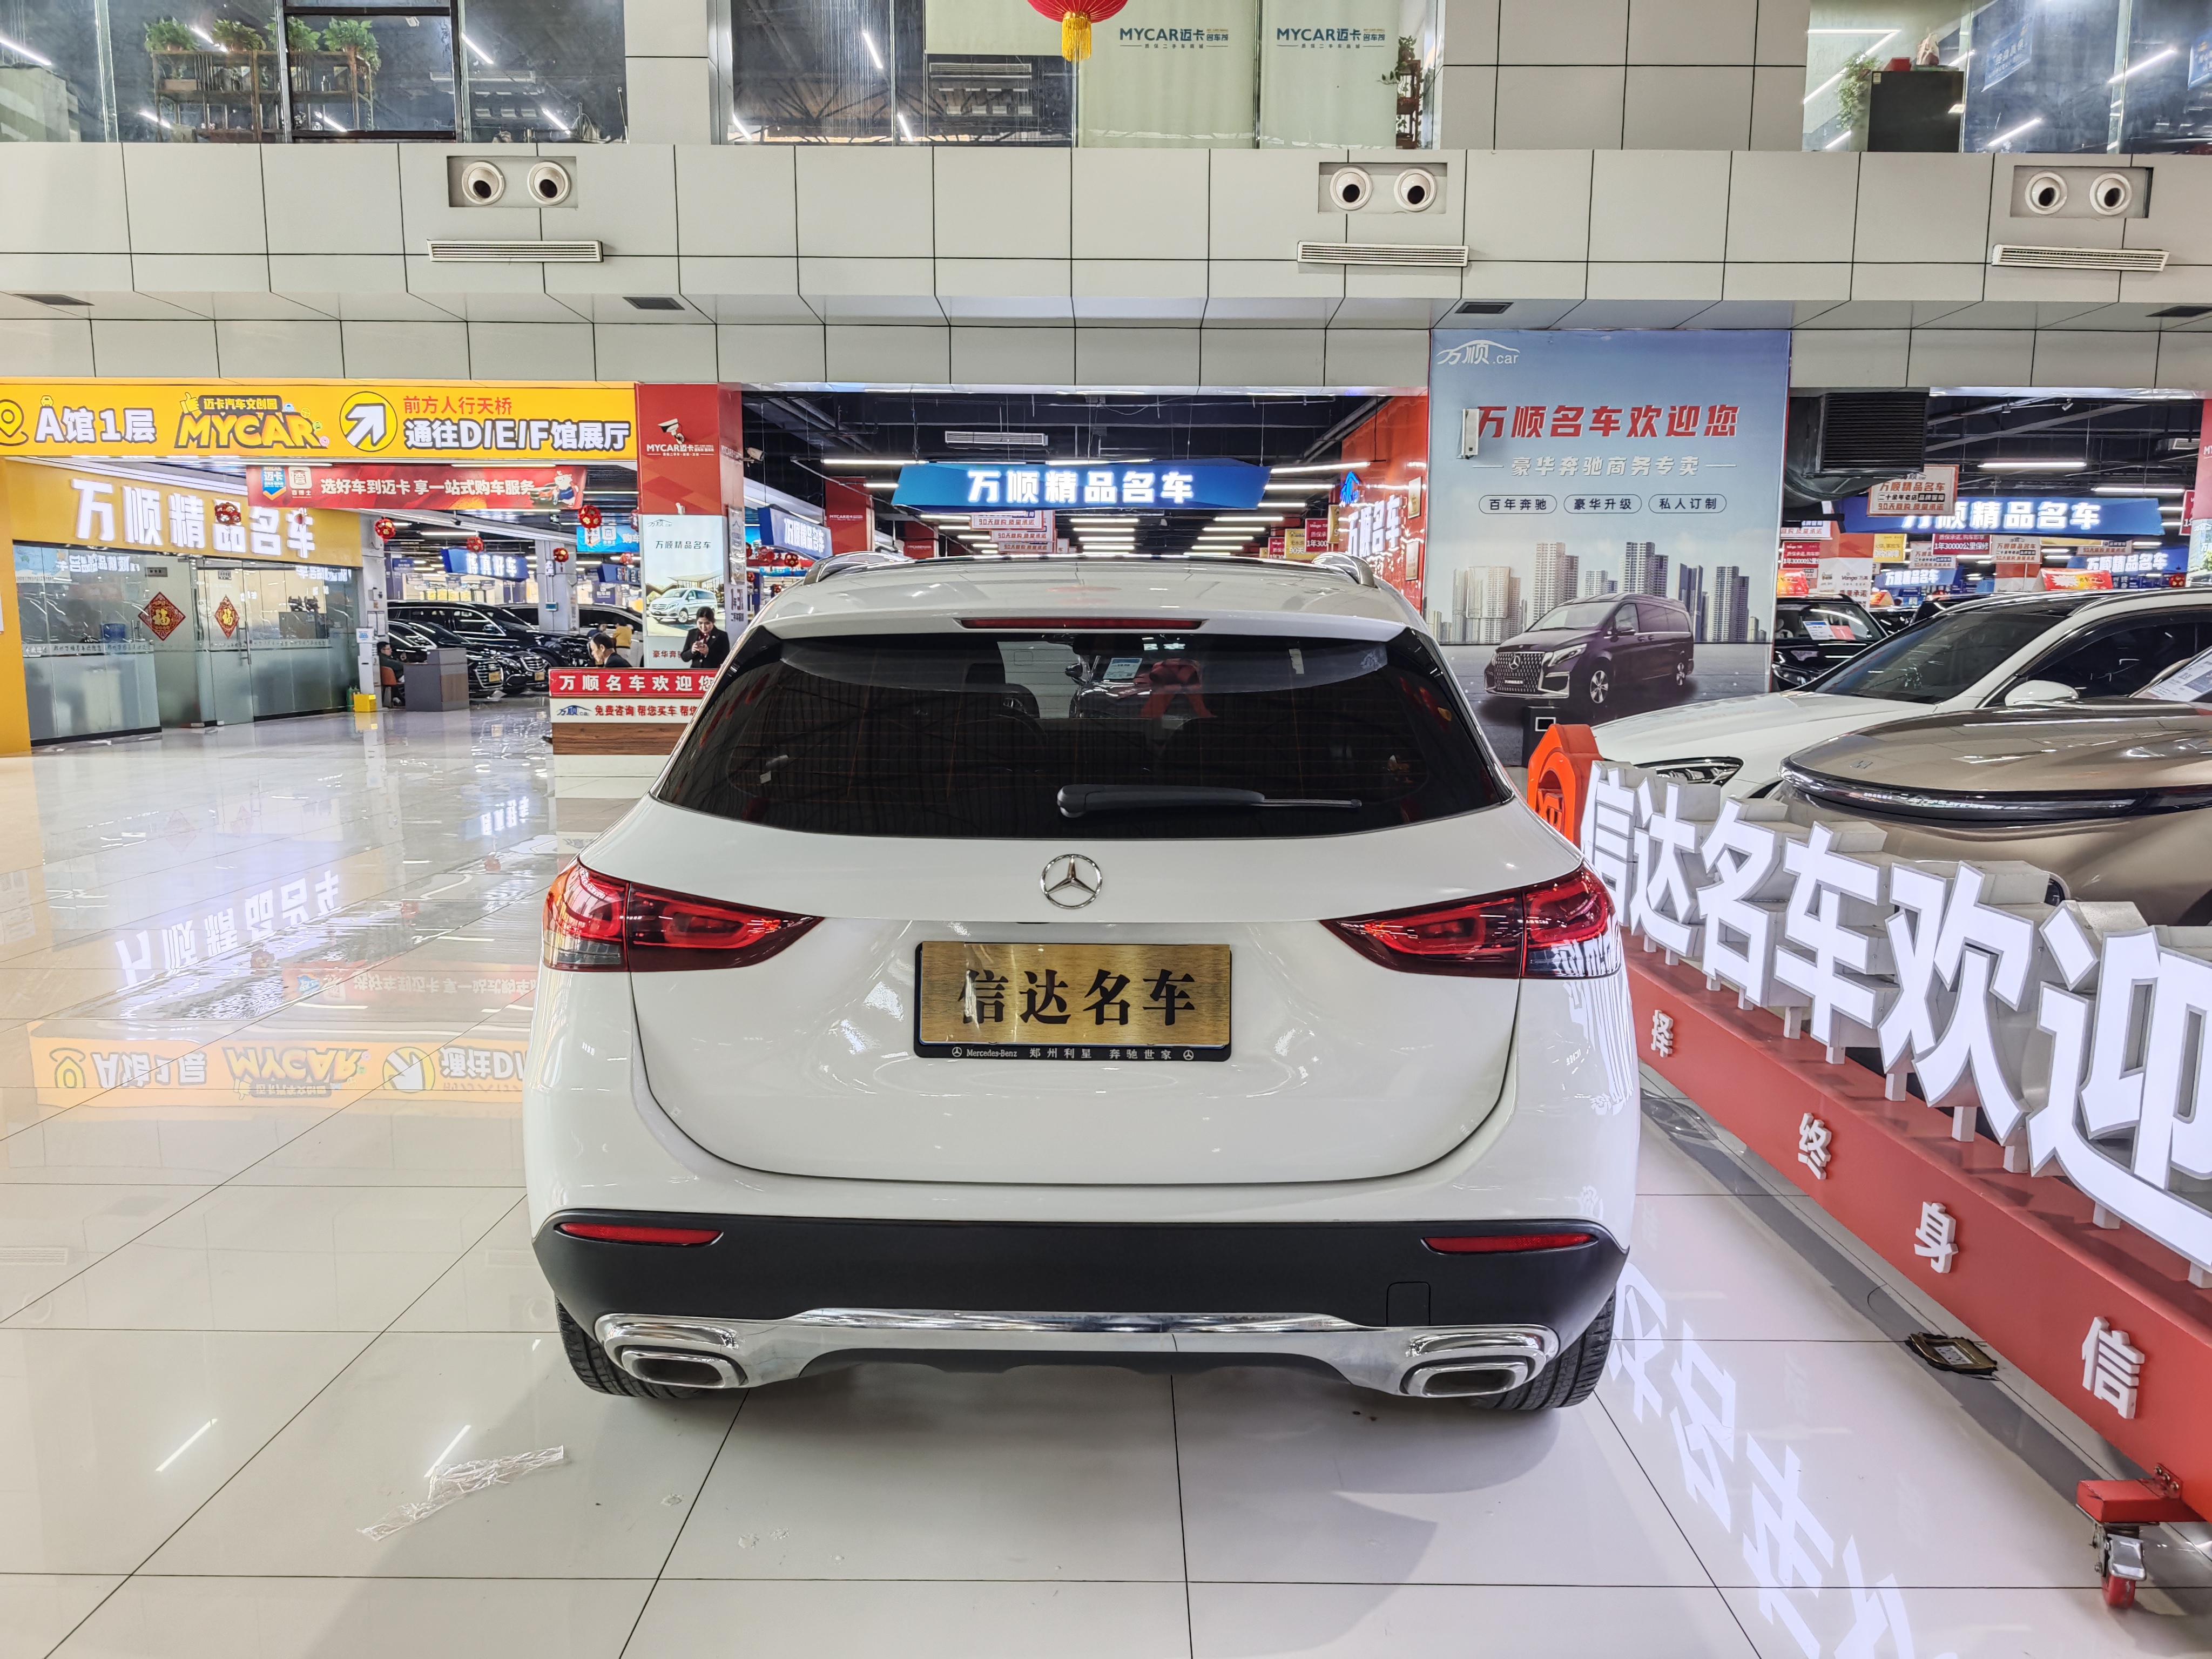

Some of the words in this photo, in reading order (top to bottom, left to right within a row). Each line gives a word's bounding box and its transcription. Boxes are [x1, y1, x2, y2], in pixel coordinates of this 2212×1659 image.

[1120, 28, 1205, 41] MYCAR迈卡
[1277, 28, 1361, 41] MYCAR迈卡
[203, 397, 278, 410] 迈卡汽车文创园
[403, 396, 512, 415] 前方人行天桥
[35, 408, 156, 443] A馆1层
[1478, 404, 1740, 438] 万顺名车欢迎您
[176, 413, 327, 449] MYCAR
[1510, 456, 1700, 477] 豪华奔驰商务专卖
[264, 471, 284, 482] 迈卡
[321, 478, 410, 495] 选好车到迈卡
[413, 479, 535, 495] 享一站式购车服务
[968, 470, 1193, 504] 万顺精品名车
[1879, 482, 1945, 492] 万顺精品名车
[1489, 498, 1547, 511] 百年奔驰
[1573, 497, 1633, 511] 豪华升级
[1659, 497, 1718, 510] 私人订制
[72, 478, 316, 558] 万顺精品名车
[655, 541, 712, 550] 万顺精品名车
[152, 608, 171, 626] 福
[222, 608, 233, 626] 福
[559, 675, 716, 692] 万顺名车欢迎您
[595, 705, 634, 717] 免费咨询
[637, 705, 676, 717] 帮您买车
[957, 968, 1196, 1026] 信达名车
[966, 1048, 1017, 1058] Mercedes-Benz
[1029, 1048, 1092, 1060] 郑州利星
[1109, 1048, 1172, 1060] 奔驰世家
